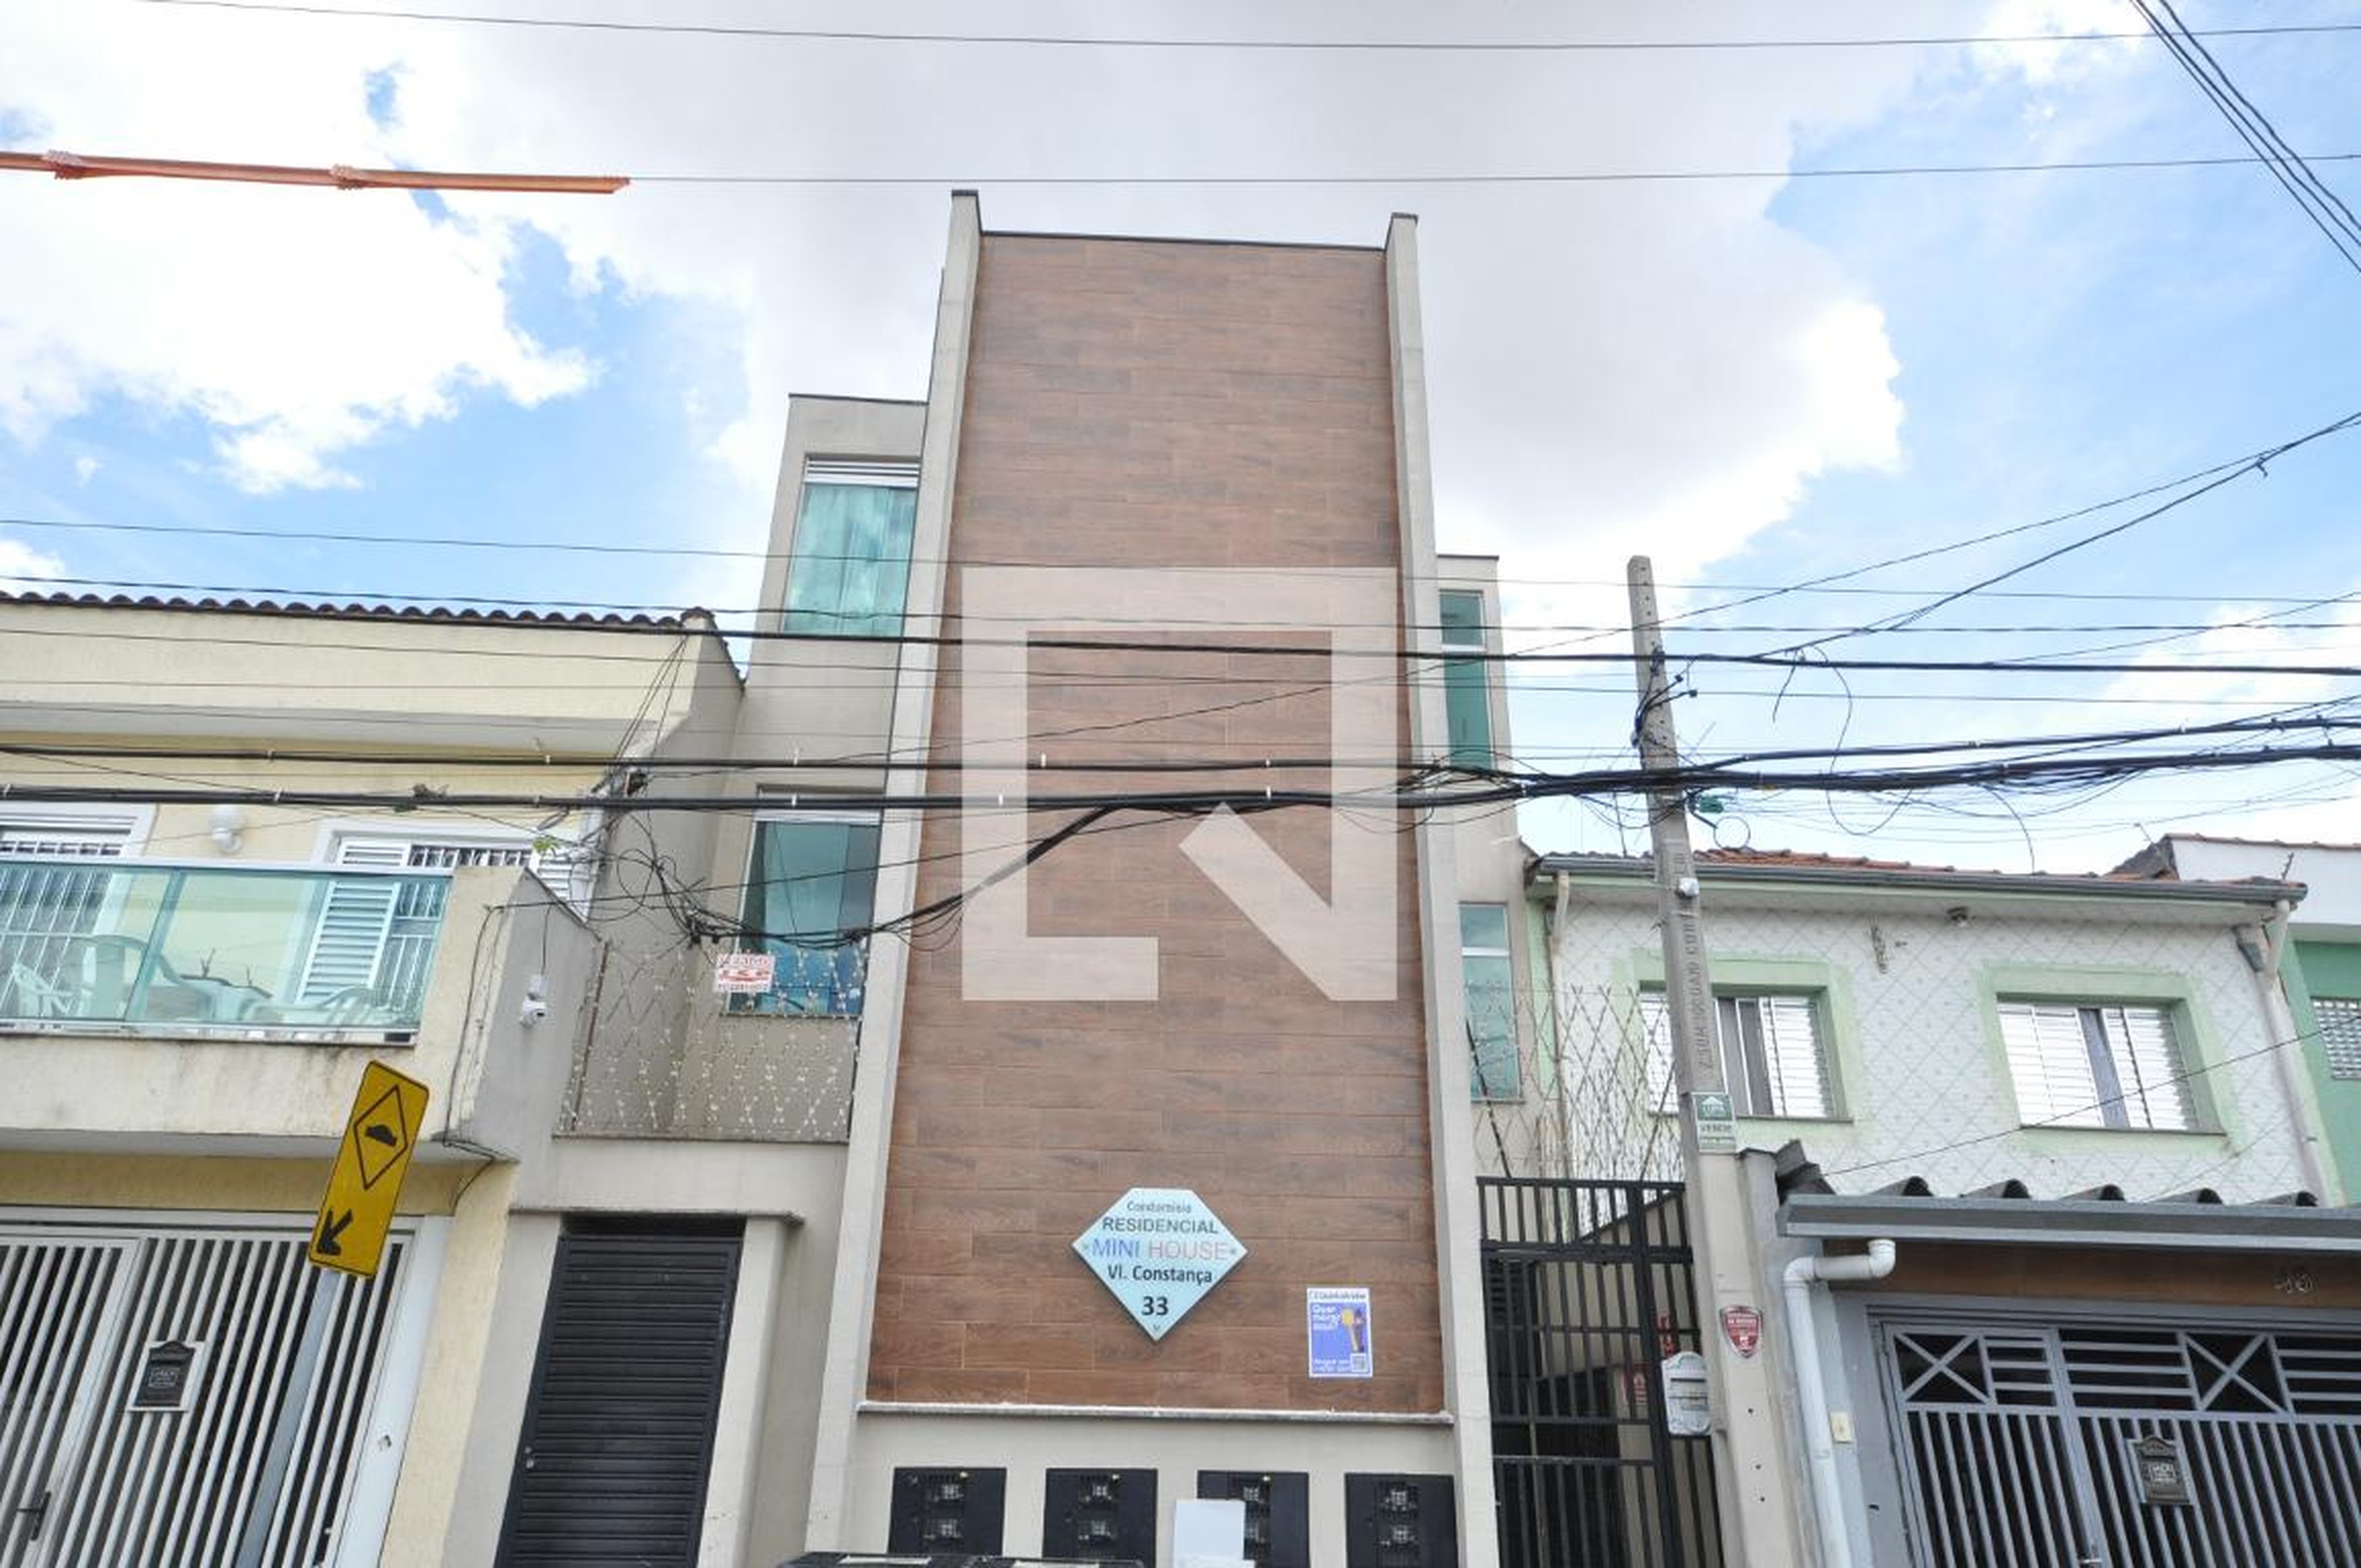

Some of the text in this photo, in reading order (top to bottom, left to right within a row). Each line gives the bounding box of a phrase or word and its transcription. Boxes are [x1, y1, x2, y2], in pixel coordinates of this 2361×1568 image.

[1102, 1216, 1219, 1234] RESIDENCIAL
[1092, 1238, 1229, 1261] MINI HOUSE
[1133, 1265, 1212, 1285] Constança
[1141, 1296, 1169, 1316] 33
